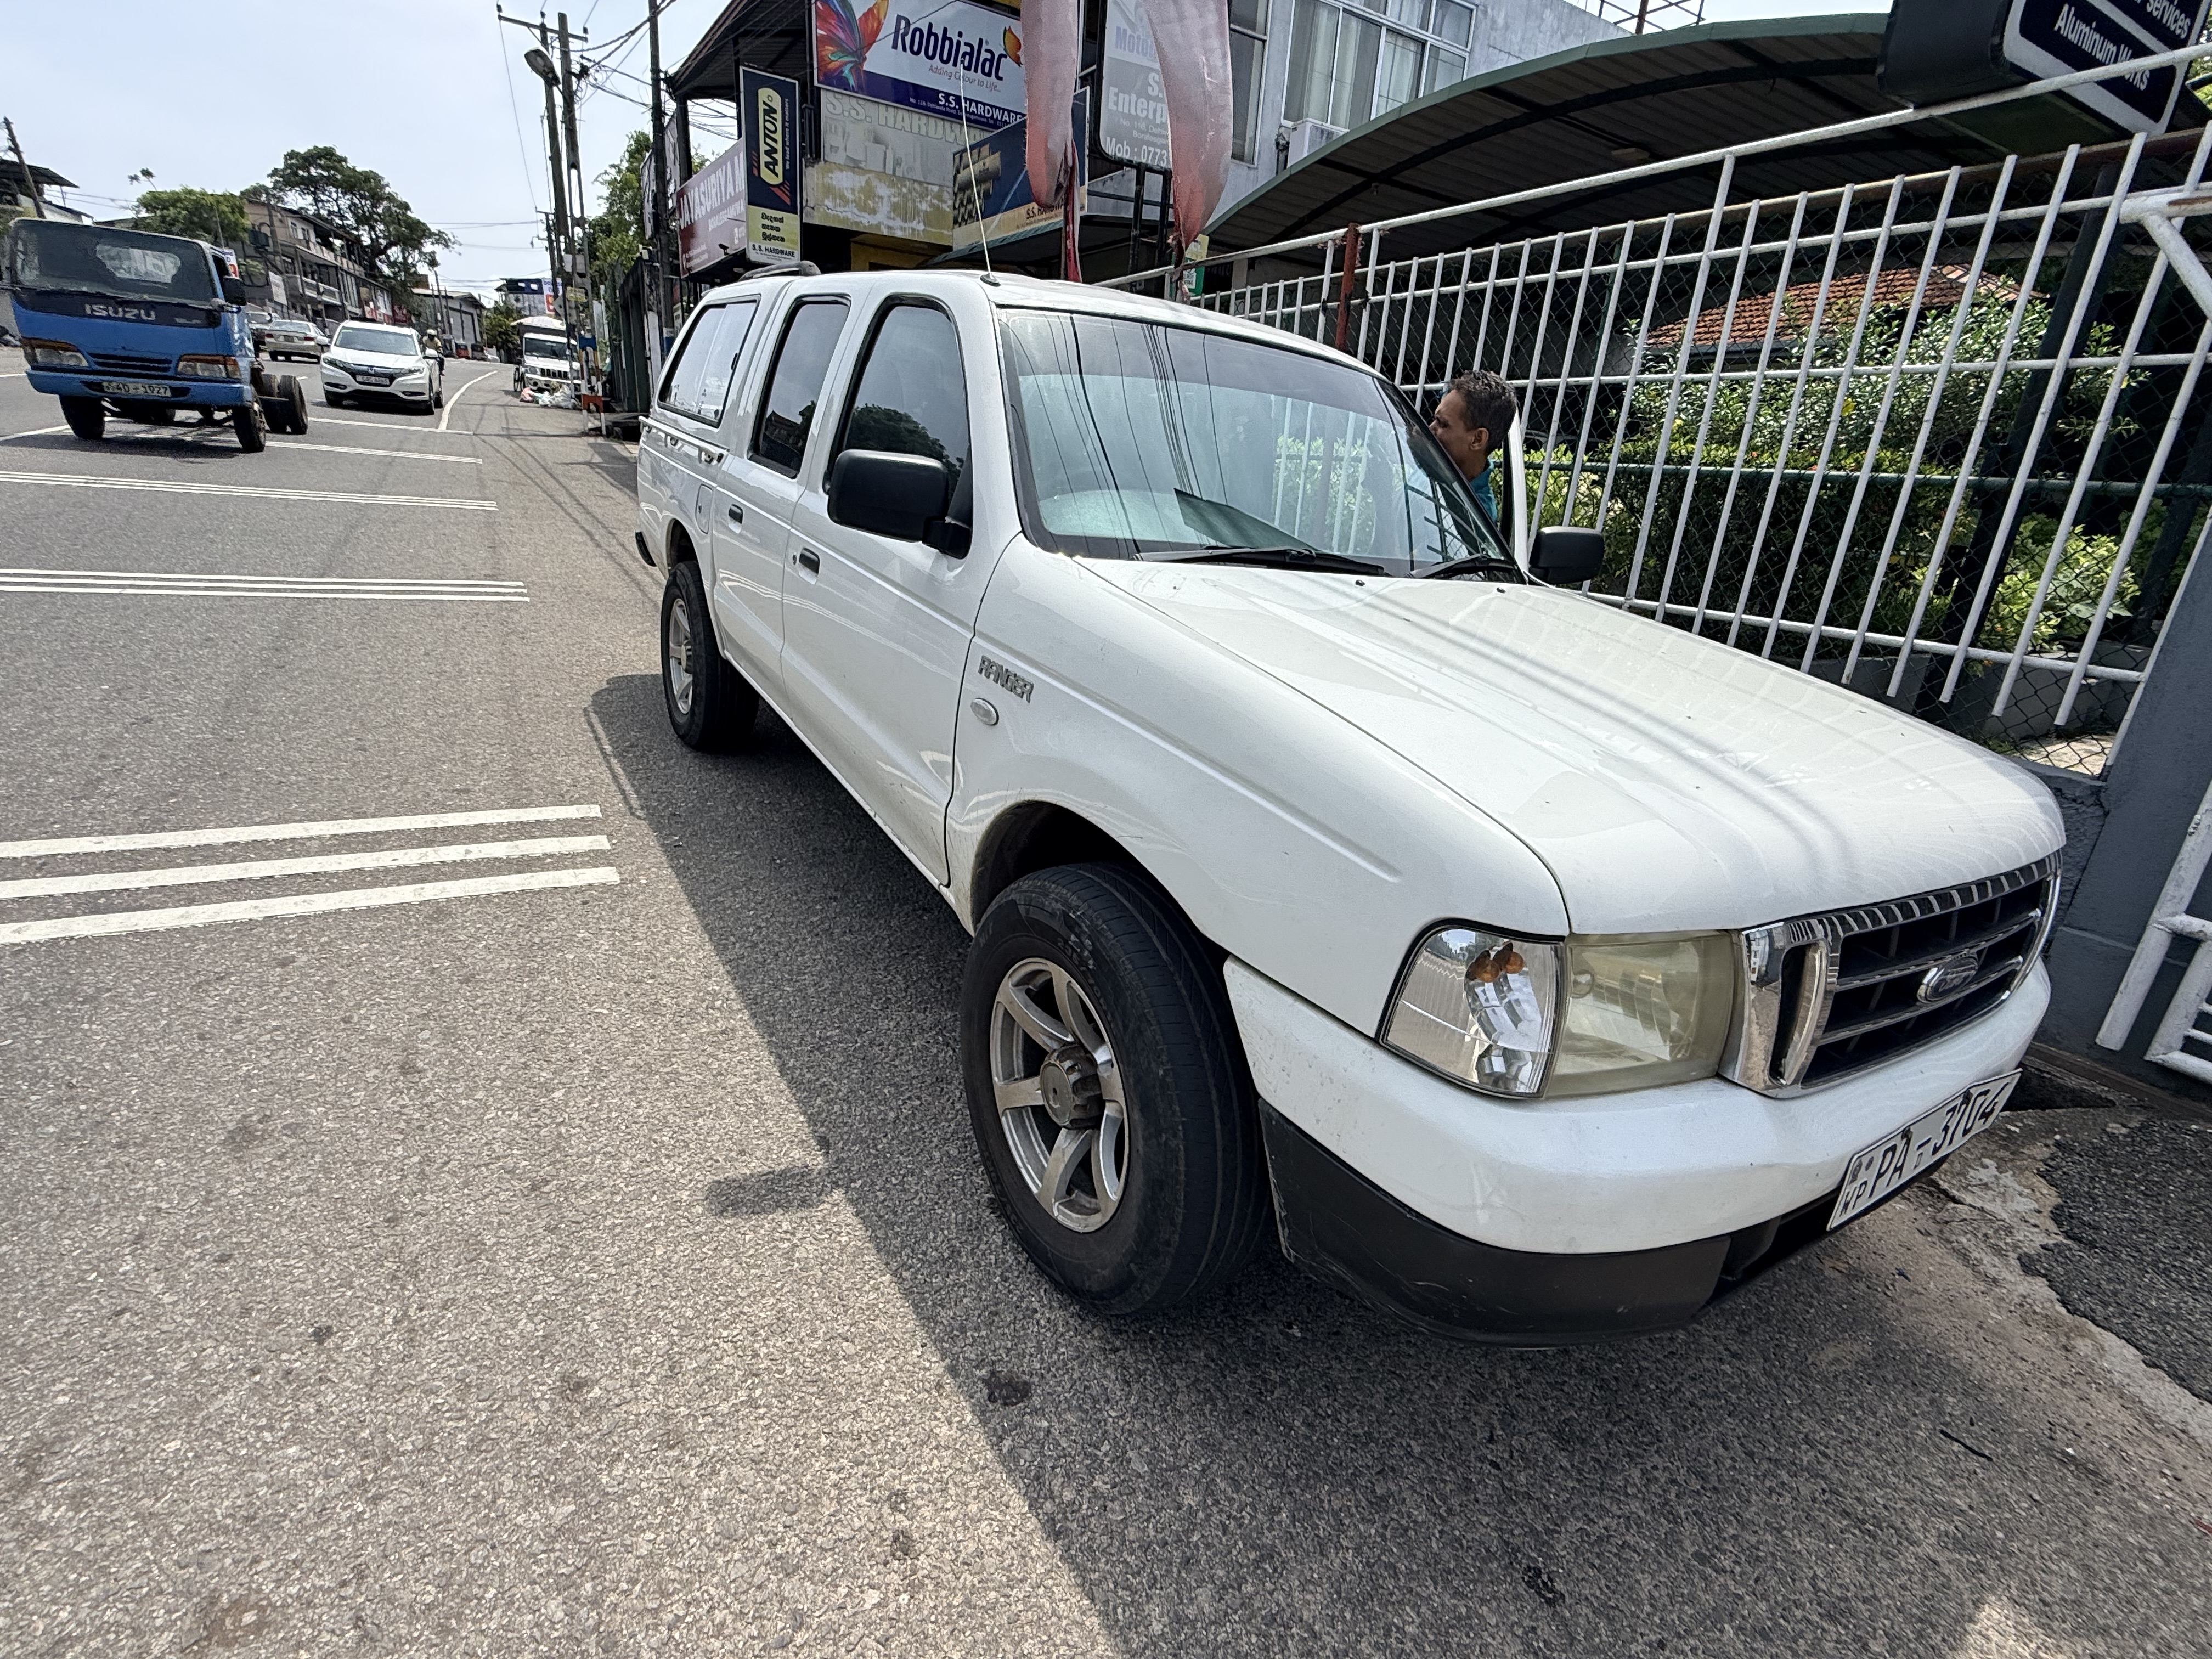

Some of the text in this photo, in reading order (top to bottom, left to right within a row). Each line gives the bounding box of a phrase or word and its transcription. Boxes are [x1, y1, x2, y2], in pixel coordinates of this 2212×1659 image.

[891, 14, 1007, 81] Robbialac
[2054, 3, 2117, 65] Aluminum
[929, 64, 953, 80] Adding
[955, 72, 977, 84] Colour
[939, 93, 959, 109] S.S.
[763, 100, 778, 178] ANTON
[1106, 137, 1131, 159] Mob
[1141, 145, 1167, 167] 0773
[765, 246, 795, 258] HARDWARE
[85, 304, 156, 321] ISUZU
[978, 655, 1034, 703] RANGER
